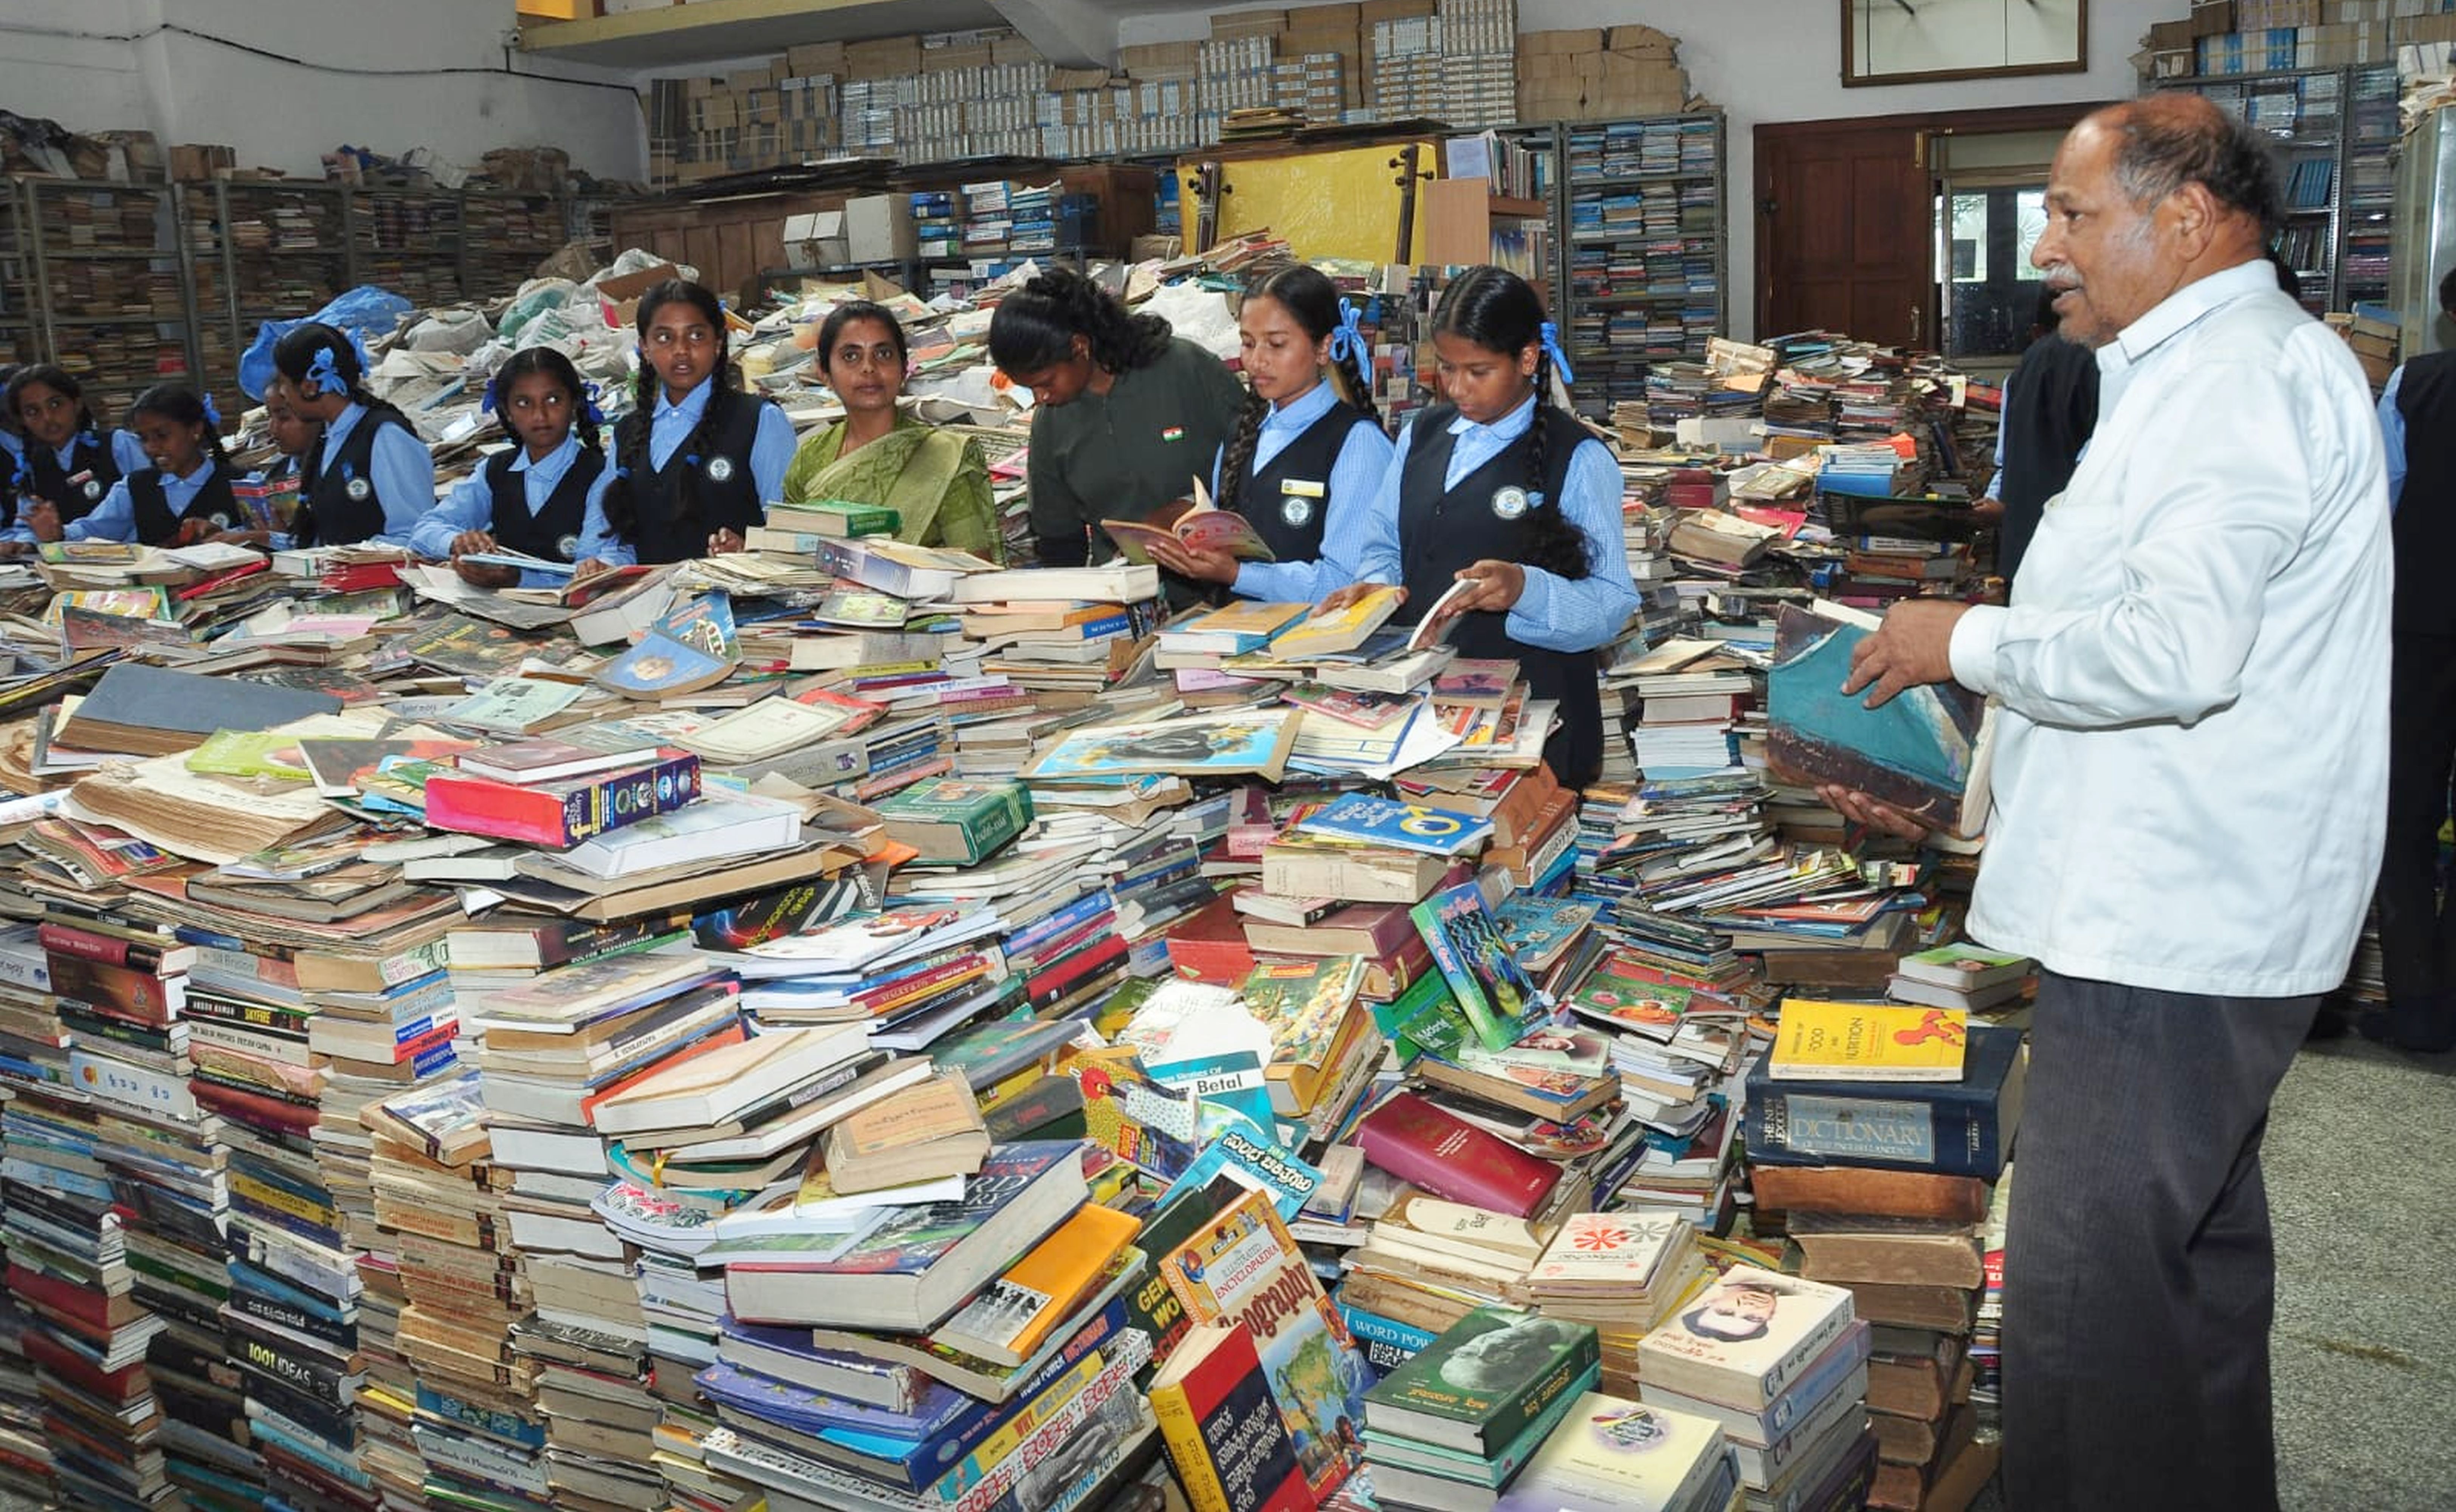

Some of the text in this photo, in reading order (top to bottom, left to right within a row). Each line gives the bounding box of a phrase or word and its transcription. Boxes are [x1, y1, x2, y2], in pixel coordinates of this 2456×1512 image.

[1197, 1073, 1243, 1094] Betal
[1794, 1117, 1922, 1147] DICTIONARY
[1215, 1244, 1279, 1300] ENCYCLOPAEDIA
[1355, 1319, 1433, 1349] WORD POW
[248, 1342, 311, 1387] 1001 IDEAS
